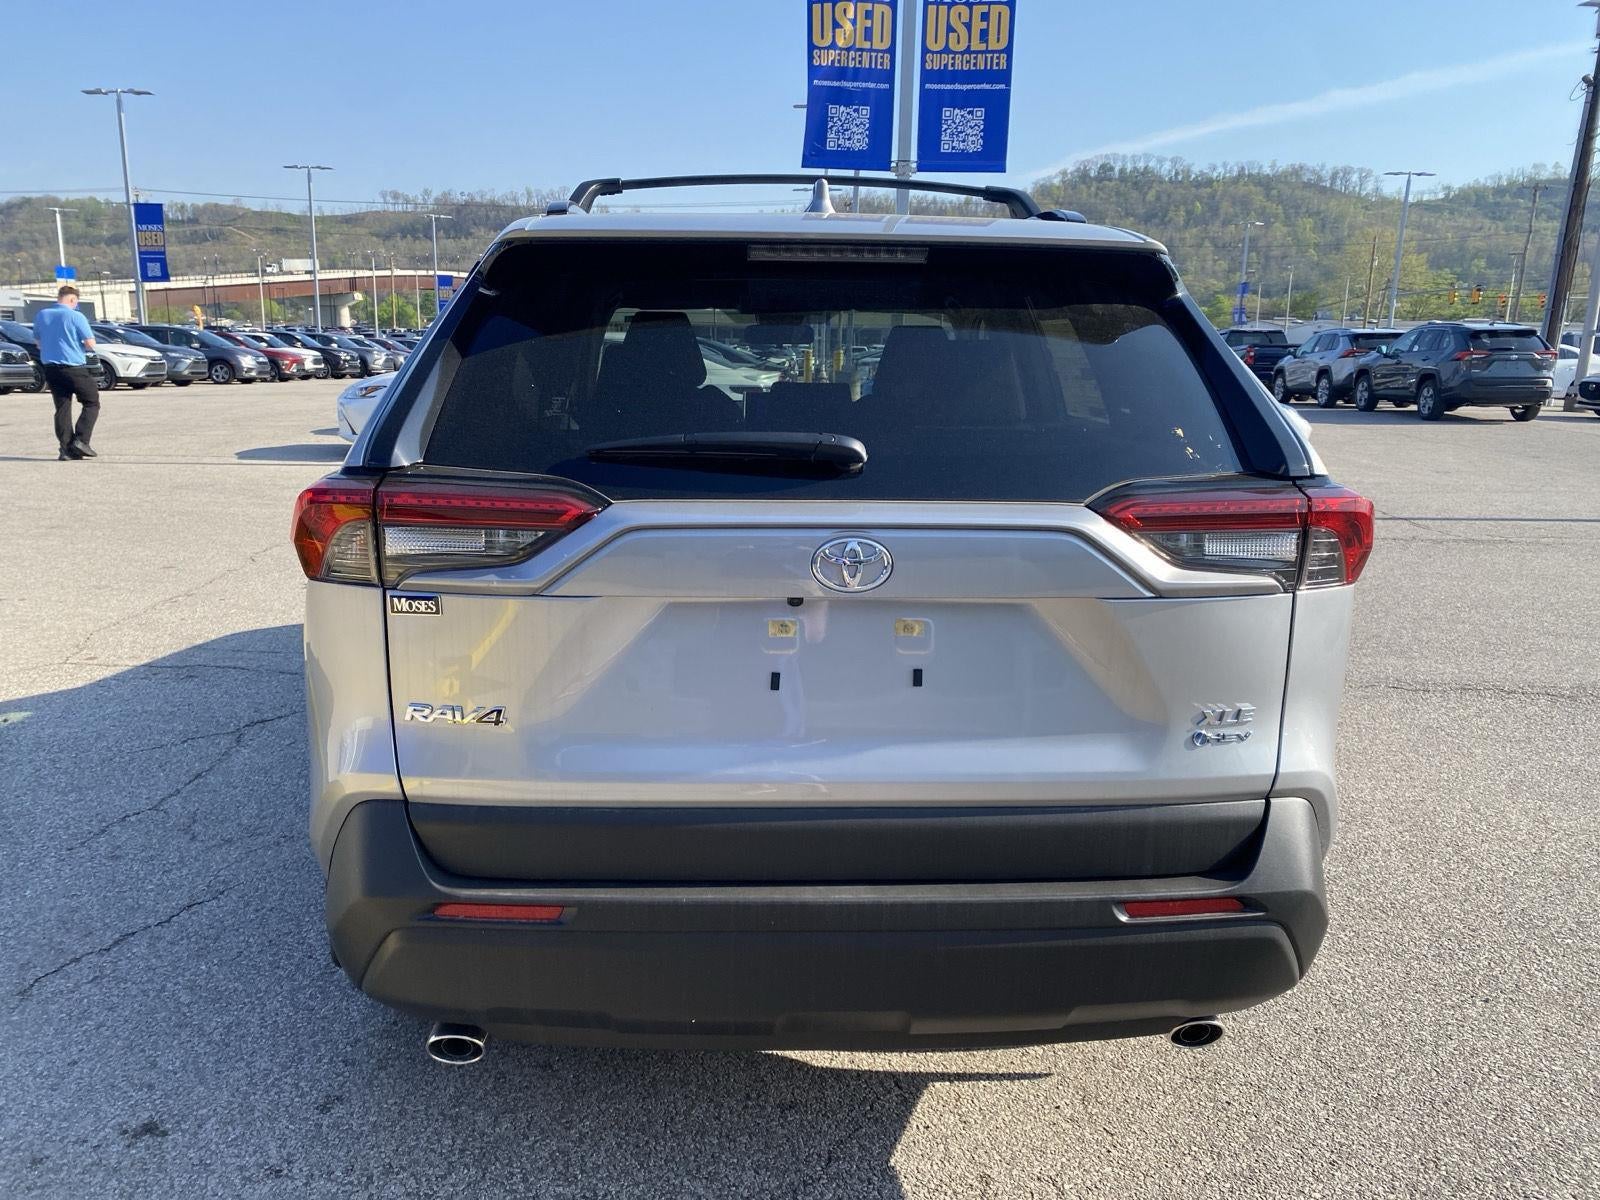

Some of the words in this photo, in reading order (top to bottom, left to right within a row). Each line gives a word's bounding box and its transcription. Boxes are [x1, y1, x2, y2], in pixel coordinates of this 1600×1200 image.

[812, 2, 892, 49] USED
[926, 4, 1010, 52] USED
[813, 50, 891, 70] SUPERCENTER
[925, 53, 1008, 71] SUPERCENTER
[813, 79, 890, 89] mosesusedsupercenter.com
[392, 597, 436, 612] MOSES
[404, 702, 507, 726] RAV4
